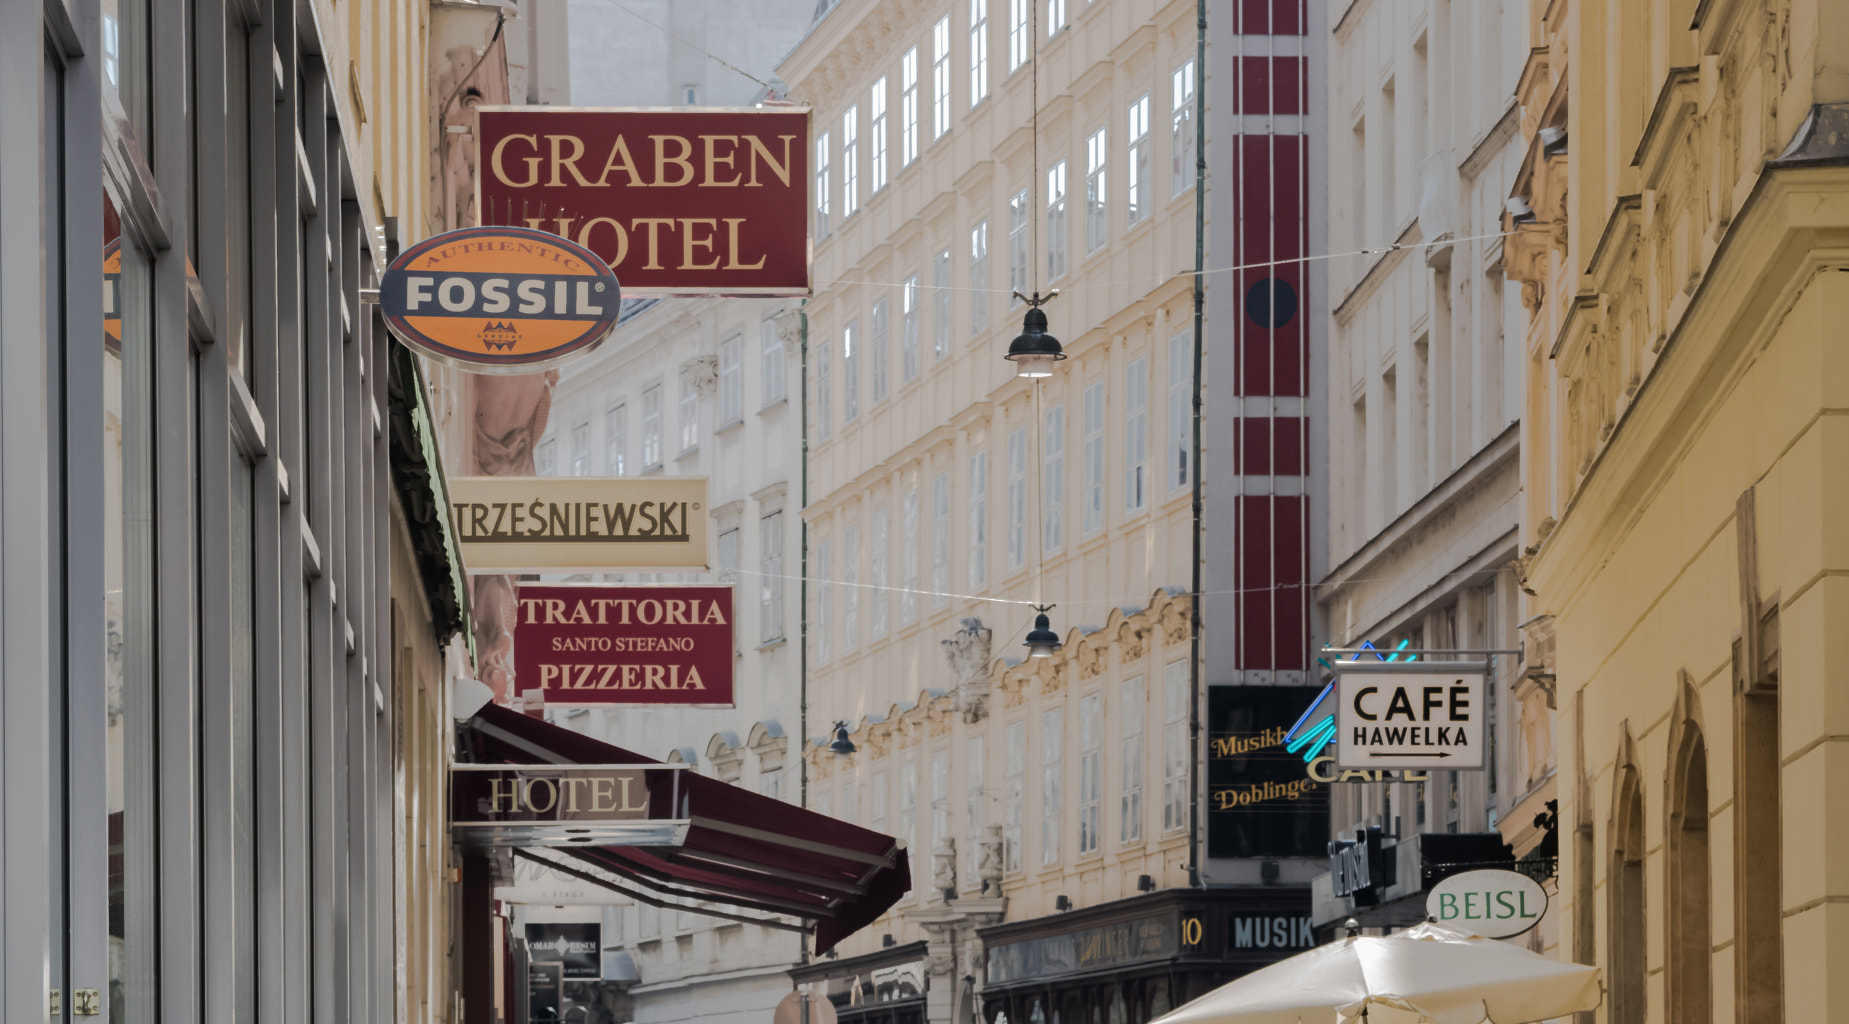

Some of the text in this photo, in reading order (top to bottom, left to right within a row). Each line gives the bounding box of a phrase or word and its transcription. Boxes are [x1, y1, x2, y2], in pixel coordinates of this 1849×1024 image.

[490, 133, 797, 189] GRABEN
[424, 240, 583, 272] AUTHENTIC
[527, 217, 767, 272] OTEL
[406, 275, 604, 316] FOSSIL
[476, 332, 523, 340] GENUINE
[453, 498, 688, 537] TRZEŚNIEWSKI
[520, 599, 727, 626] TRATTORIA
[552, 637, 694, 652] SANTO STEFANO
[538, 664, 706, 690] PIZZERIA
[1353, 679, 1470, 722] CAFÉ
[1210, 726, 1289, 758] Musikh
[1353, 726, 1468, 747] HAWELKA
[487, 777, 648, 814] HOTEL
[1438, 891, 1538, 921] BEISL
[1181, 917, 1203, 946] 10
[1234, 916, 1315, 949] MUSIK
